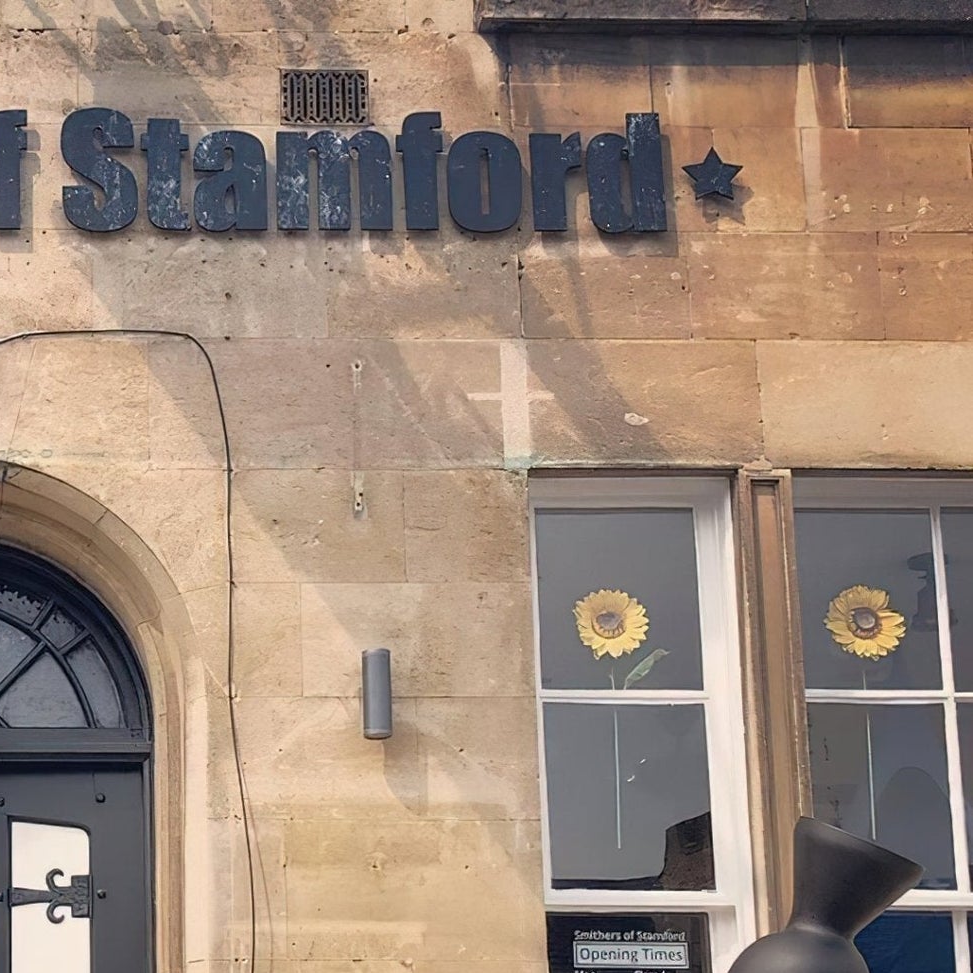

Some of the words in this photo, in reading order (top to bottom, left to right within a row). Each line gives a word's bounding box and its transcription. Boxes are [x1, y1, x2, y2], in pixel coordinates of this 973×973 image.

[61, 107, 667, 234] Stamford
[574, 930, 621, 940] Smithers
[623, 930, 635, 940] of
[636, 929, 686, 941] Stamford
[580, 948, 639, 962] Opening
[642, 948, 683, 961] Times
